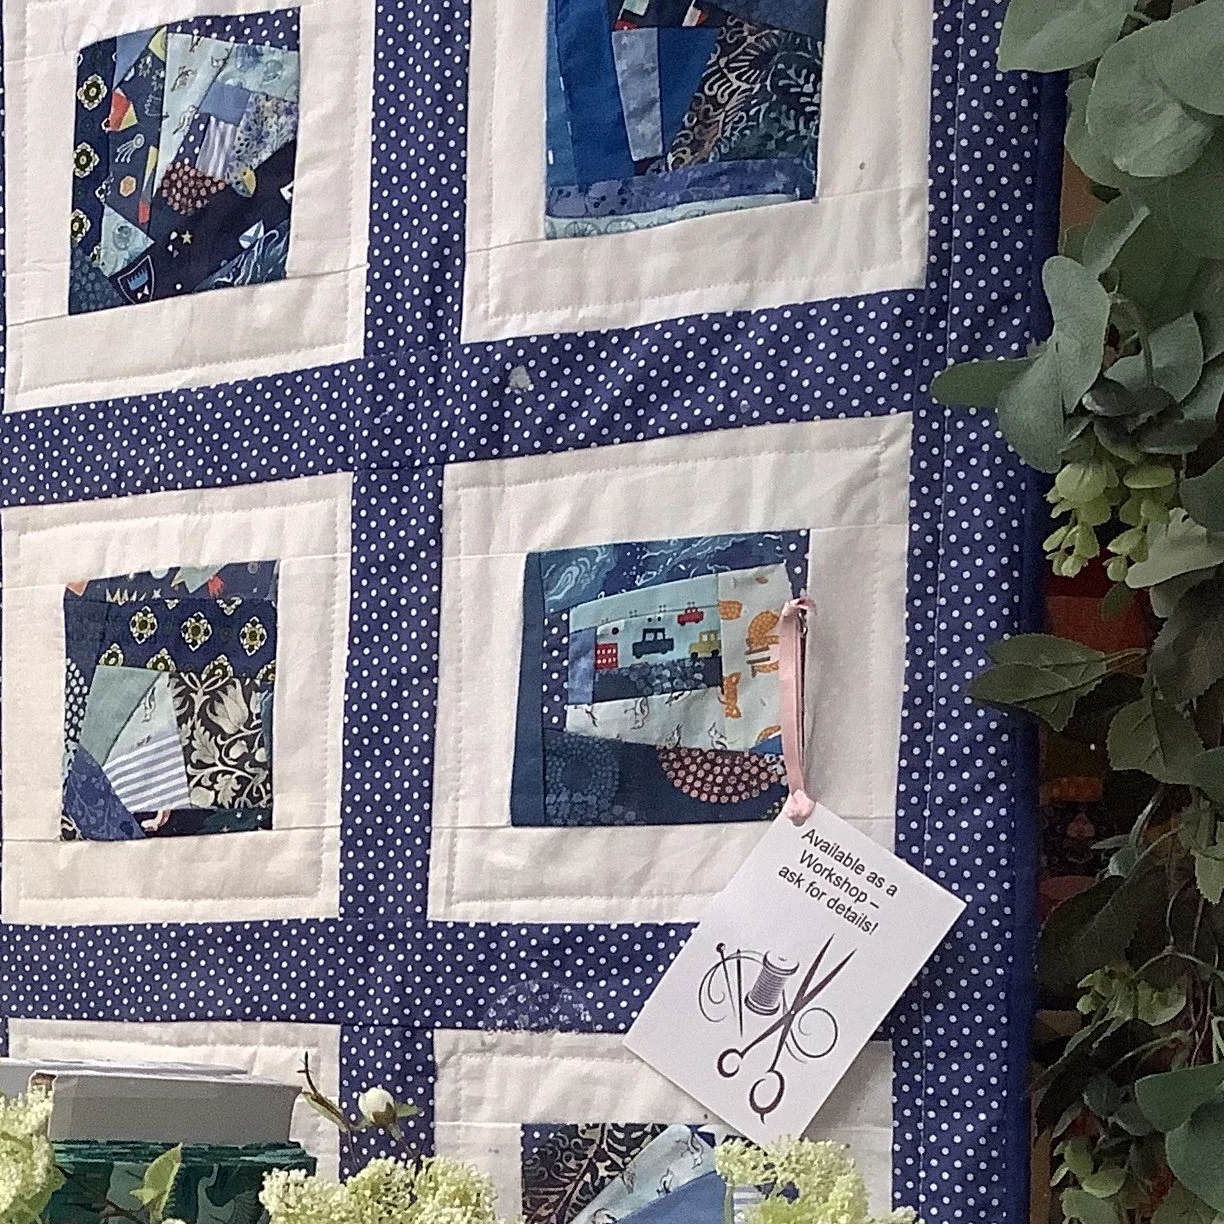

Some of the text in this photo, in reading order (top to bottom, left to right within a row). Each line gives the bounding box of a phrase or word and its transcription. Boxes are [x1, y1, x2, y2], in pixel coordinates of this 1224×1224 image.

[799, 849, 868, 903] Workshop
[801, 828, 898, 897] Available as a
[778, 866, 879, 936] ask for details!
